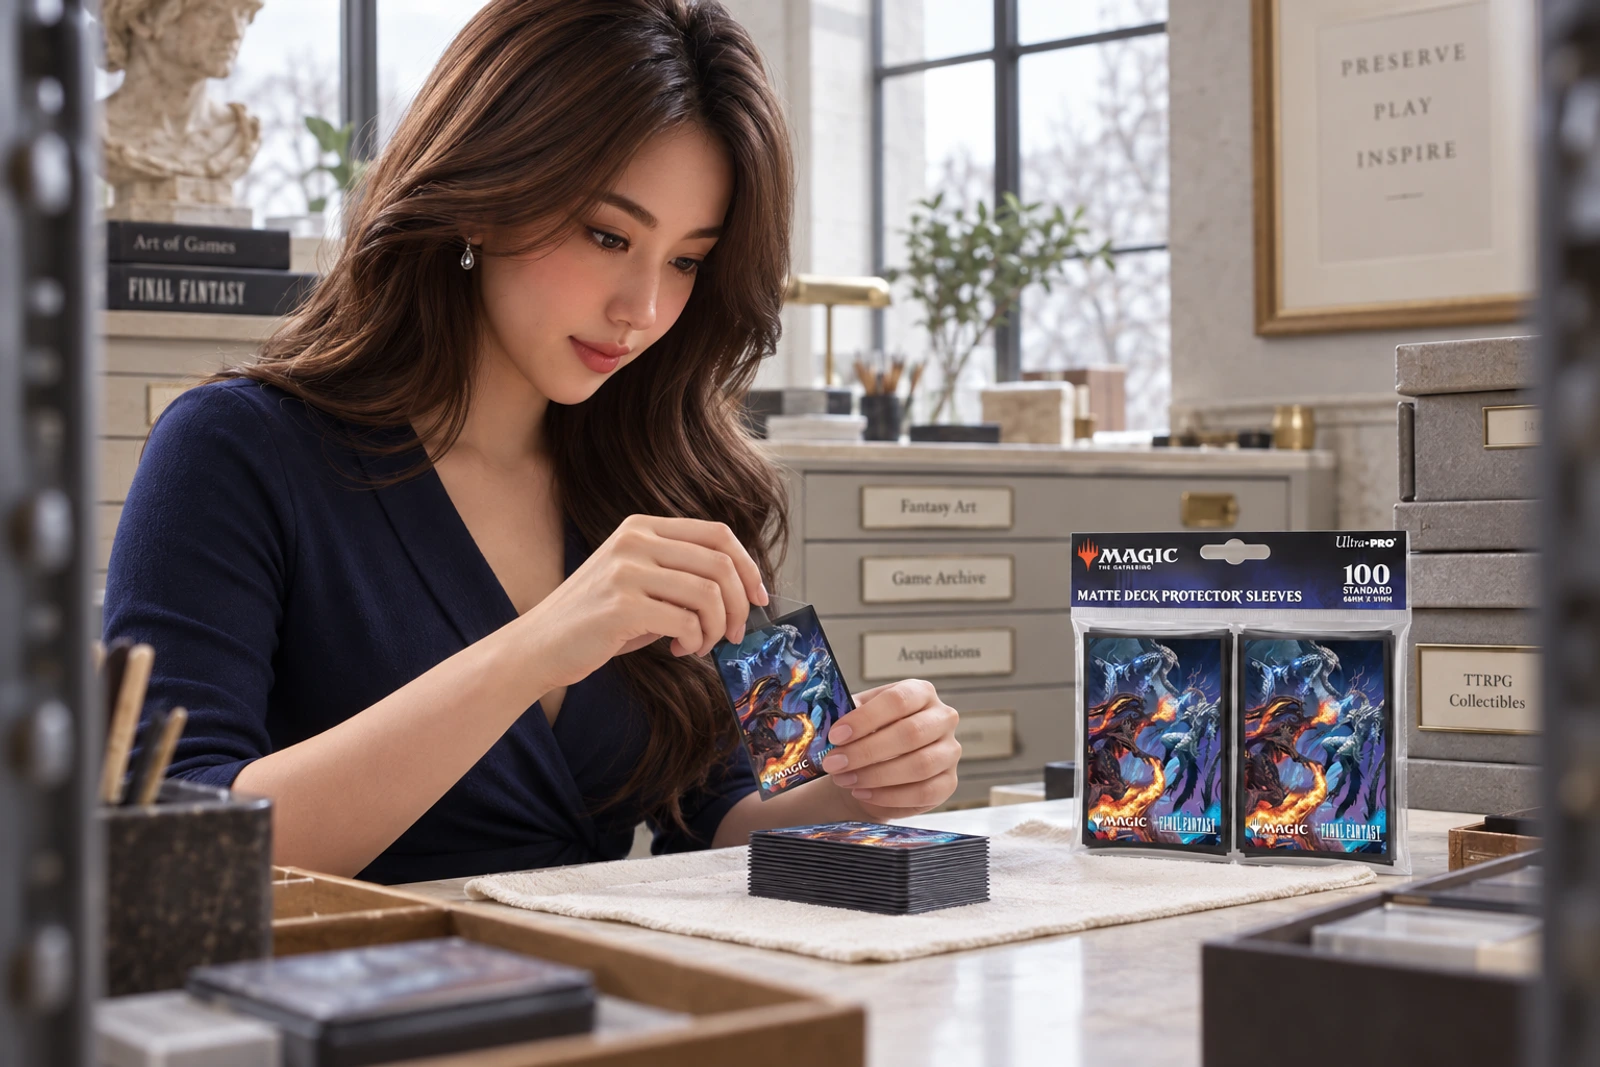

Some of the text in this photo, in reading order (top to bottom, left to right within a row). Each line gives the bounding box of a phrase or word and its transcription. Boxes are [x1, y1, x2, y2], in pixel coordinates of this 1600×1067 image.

[1341, 42, 1466, 78] PRESERVE
[1374, 96, 1432, 121] PLAY
[1356, 140, 1457, 169] INSPIRE
[133, 233, 237, 254] Art of Games
[128, 277, 246, 305] FINAL FANTASY
[900, 498, 977, 518] Fantasy Art
[1098, 548, 1179, 565] MAGIC
[891, 569, 987, 586] Game Archive
[1343, 563, 1391, 585] 100
[1077, 589, 1121, 601] MATTE
[1125, 589, 1160, 603] DECK
[1246, 590, 1303, 603] SLEEVES
[1342, 586, 1393, 595] STANDARD
[897, 644, 982, 665] Acquisitions
[1463, 673, 1513, 688] TTRPG
[1449, 693, 1526, 709] Collectibles
[774, 759, 810, 781] MAGIC
[1103, 816, 1147, 828] MAGIC
[1261, 823, 1309, 835] MAGIC
[1321, 823, 1344, 839] FINAL
